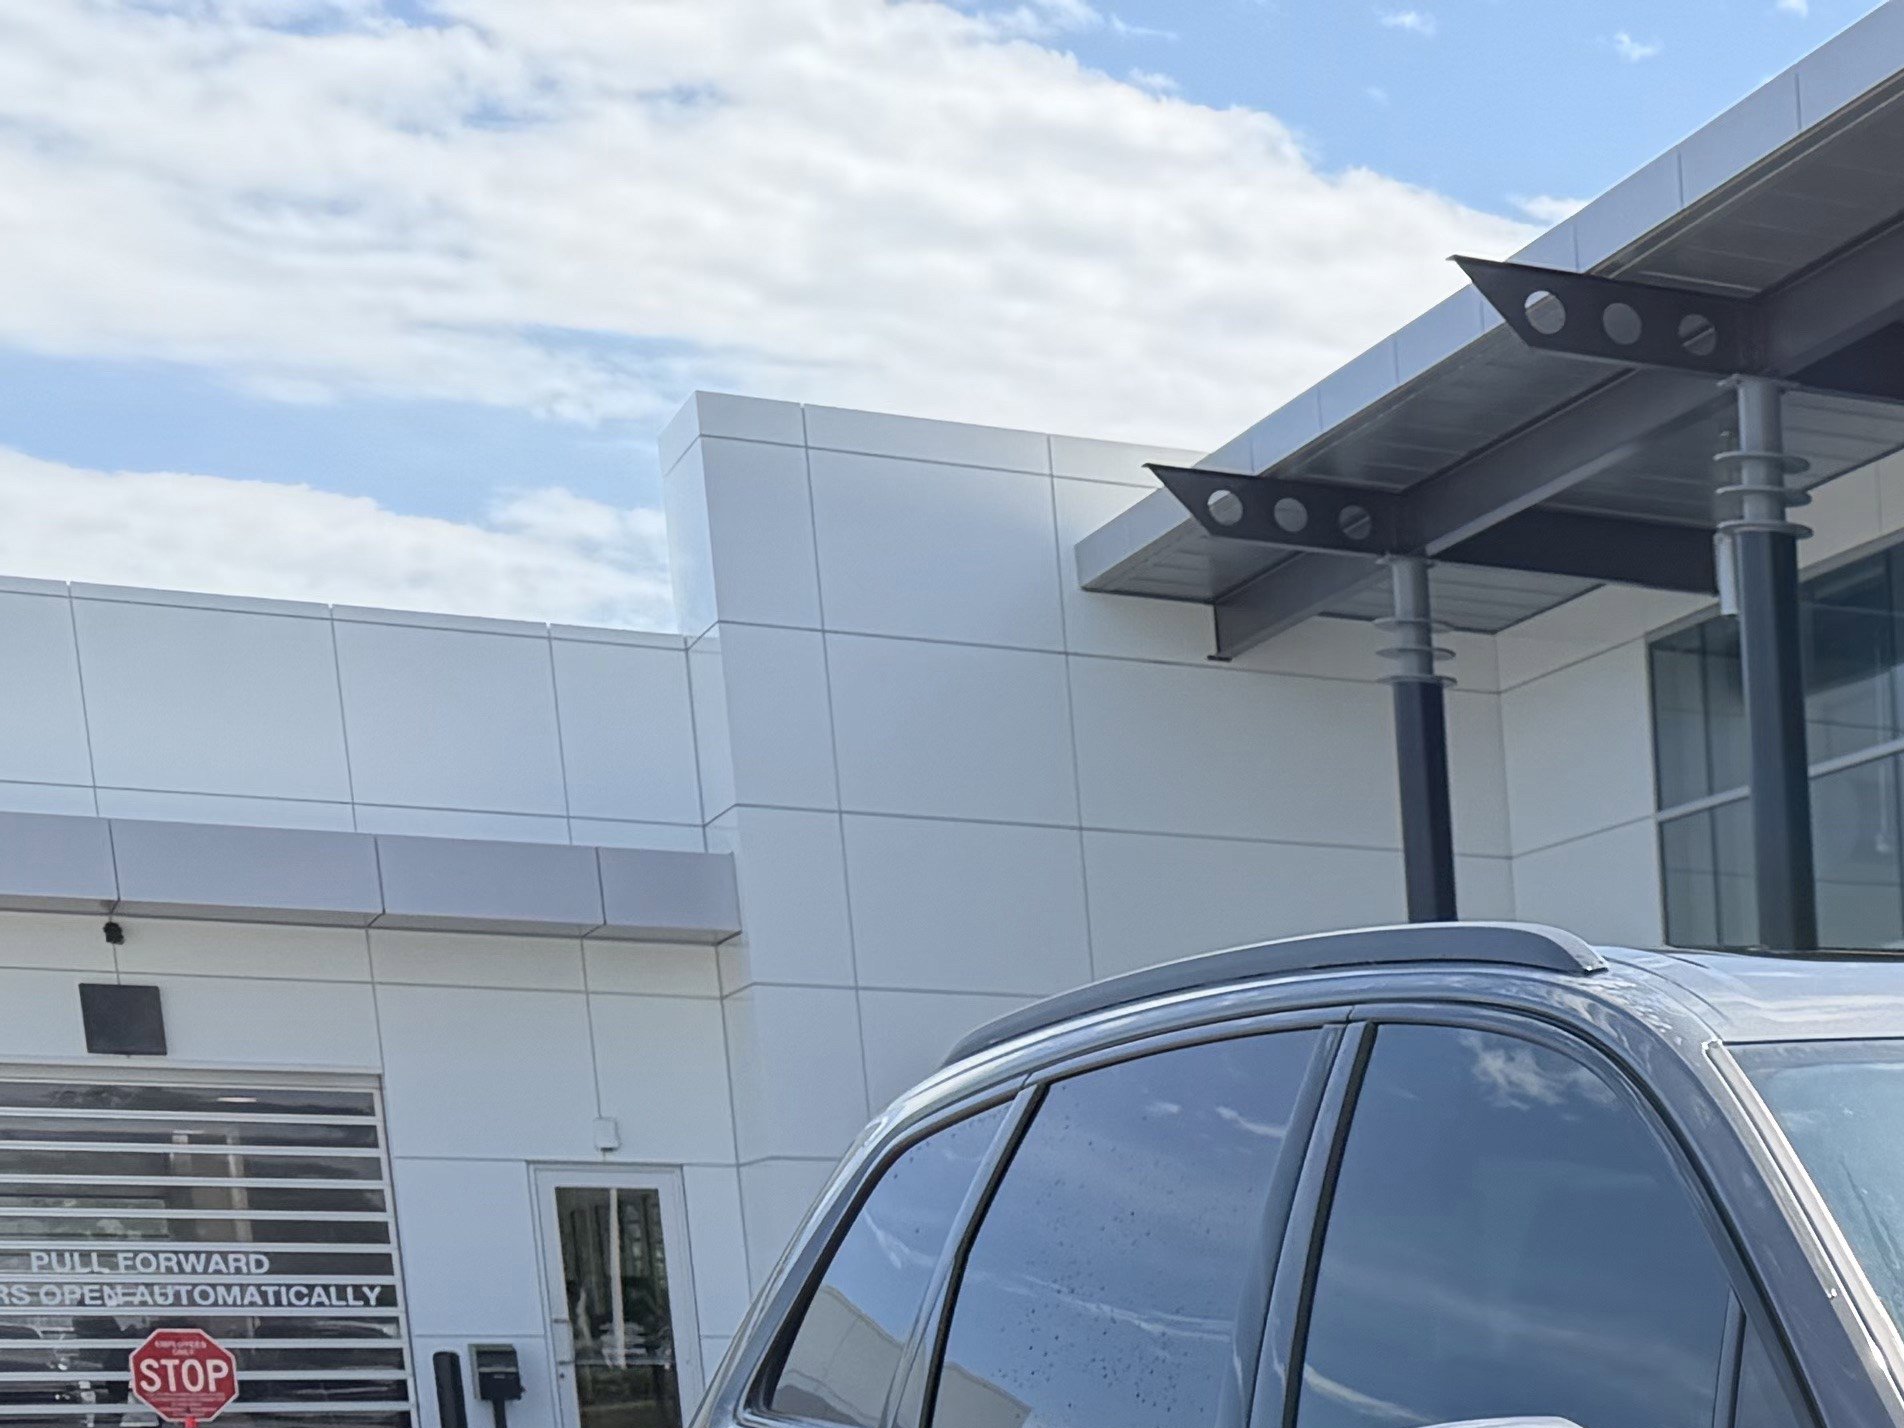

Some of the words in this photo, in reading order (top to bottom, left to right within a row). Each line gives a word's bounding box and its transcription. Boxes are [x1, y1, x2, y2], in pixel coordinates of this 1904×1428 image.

[31, 1252, 110, 1274] PULL
[116, 1253, 270, 1274] FORWARD
[40, 1284, 123, 1306] OPEN
[134, 1284, 381, 1306] AUTOMATICALLY
[140, 1358, 229, 1392] STOP
